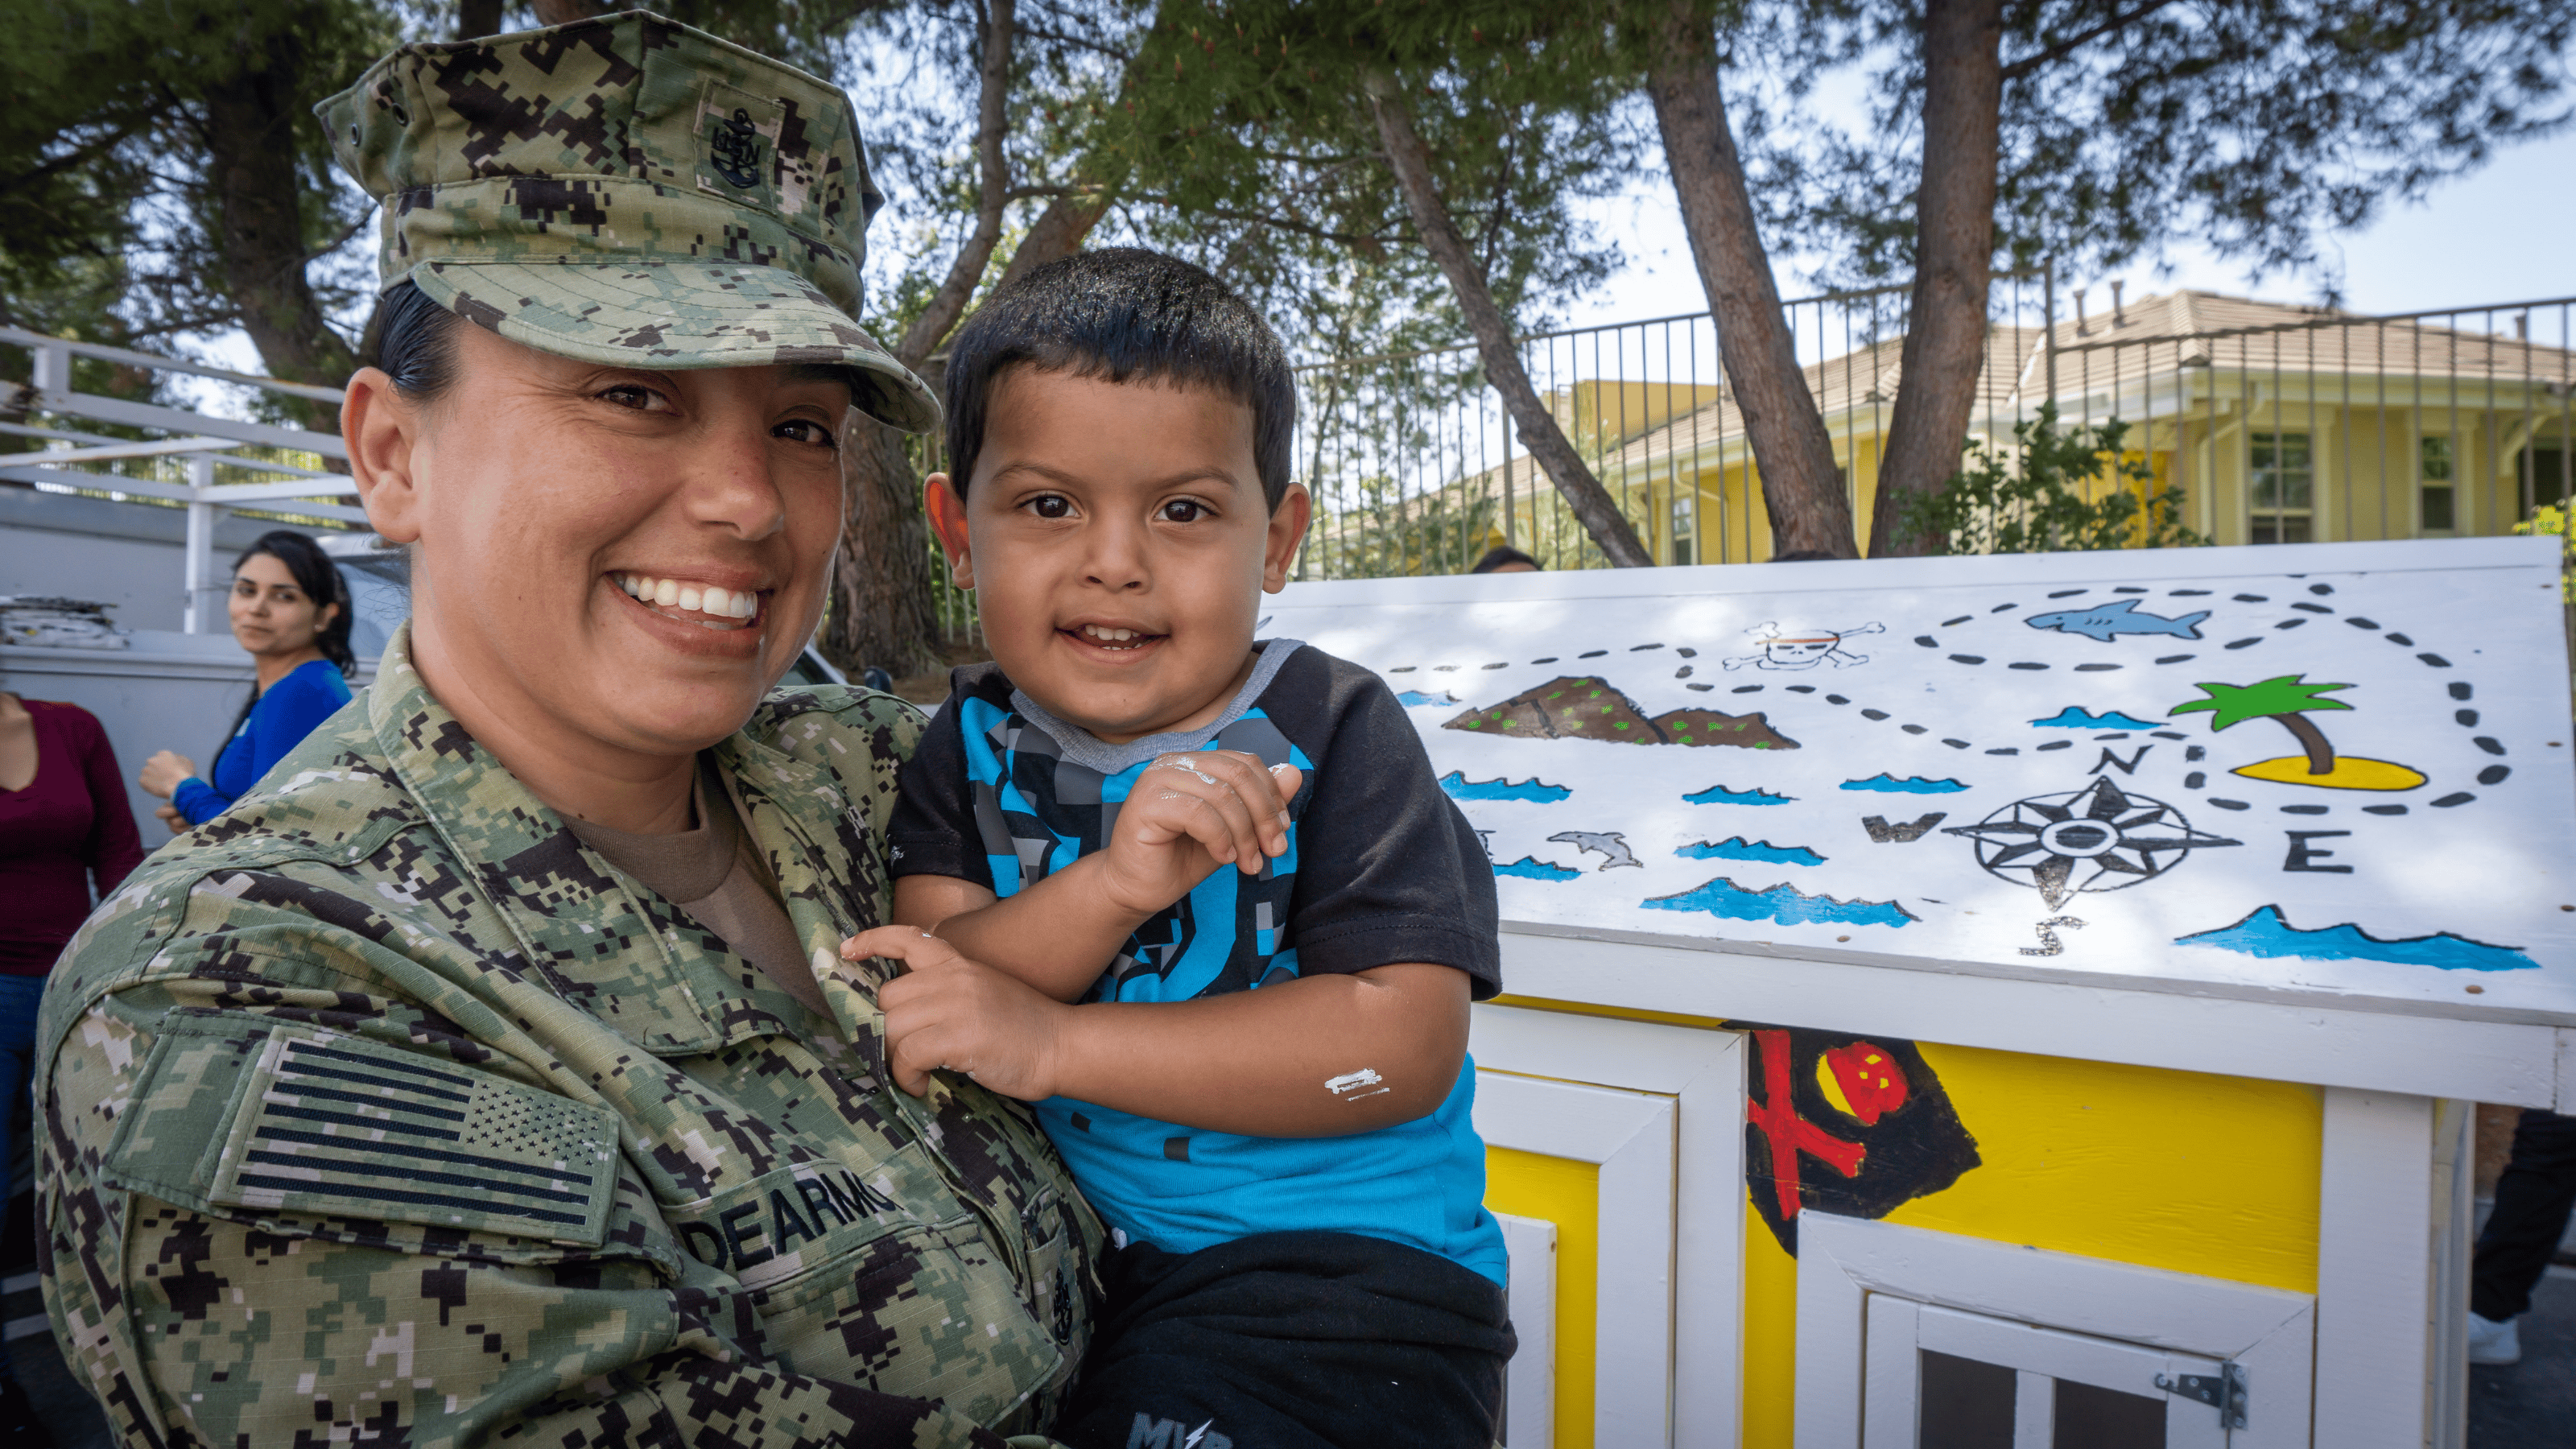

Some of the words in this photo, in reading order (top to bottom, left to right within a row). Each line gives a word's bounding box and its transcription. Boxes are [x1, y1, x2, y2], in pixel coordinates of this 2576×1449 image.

[2087, 744, 2155, 776] N
[1861, 811, 1948, 844] W
[2282, 830, 2355, 874] E
[2017, 915, 2091, 957] S
